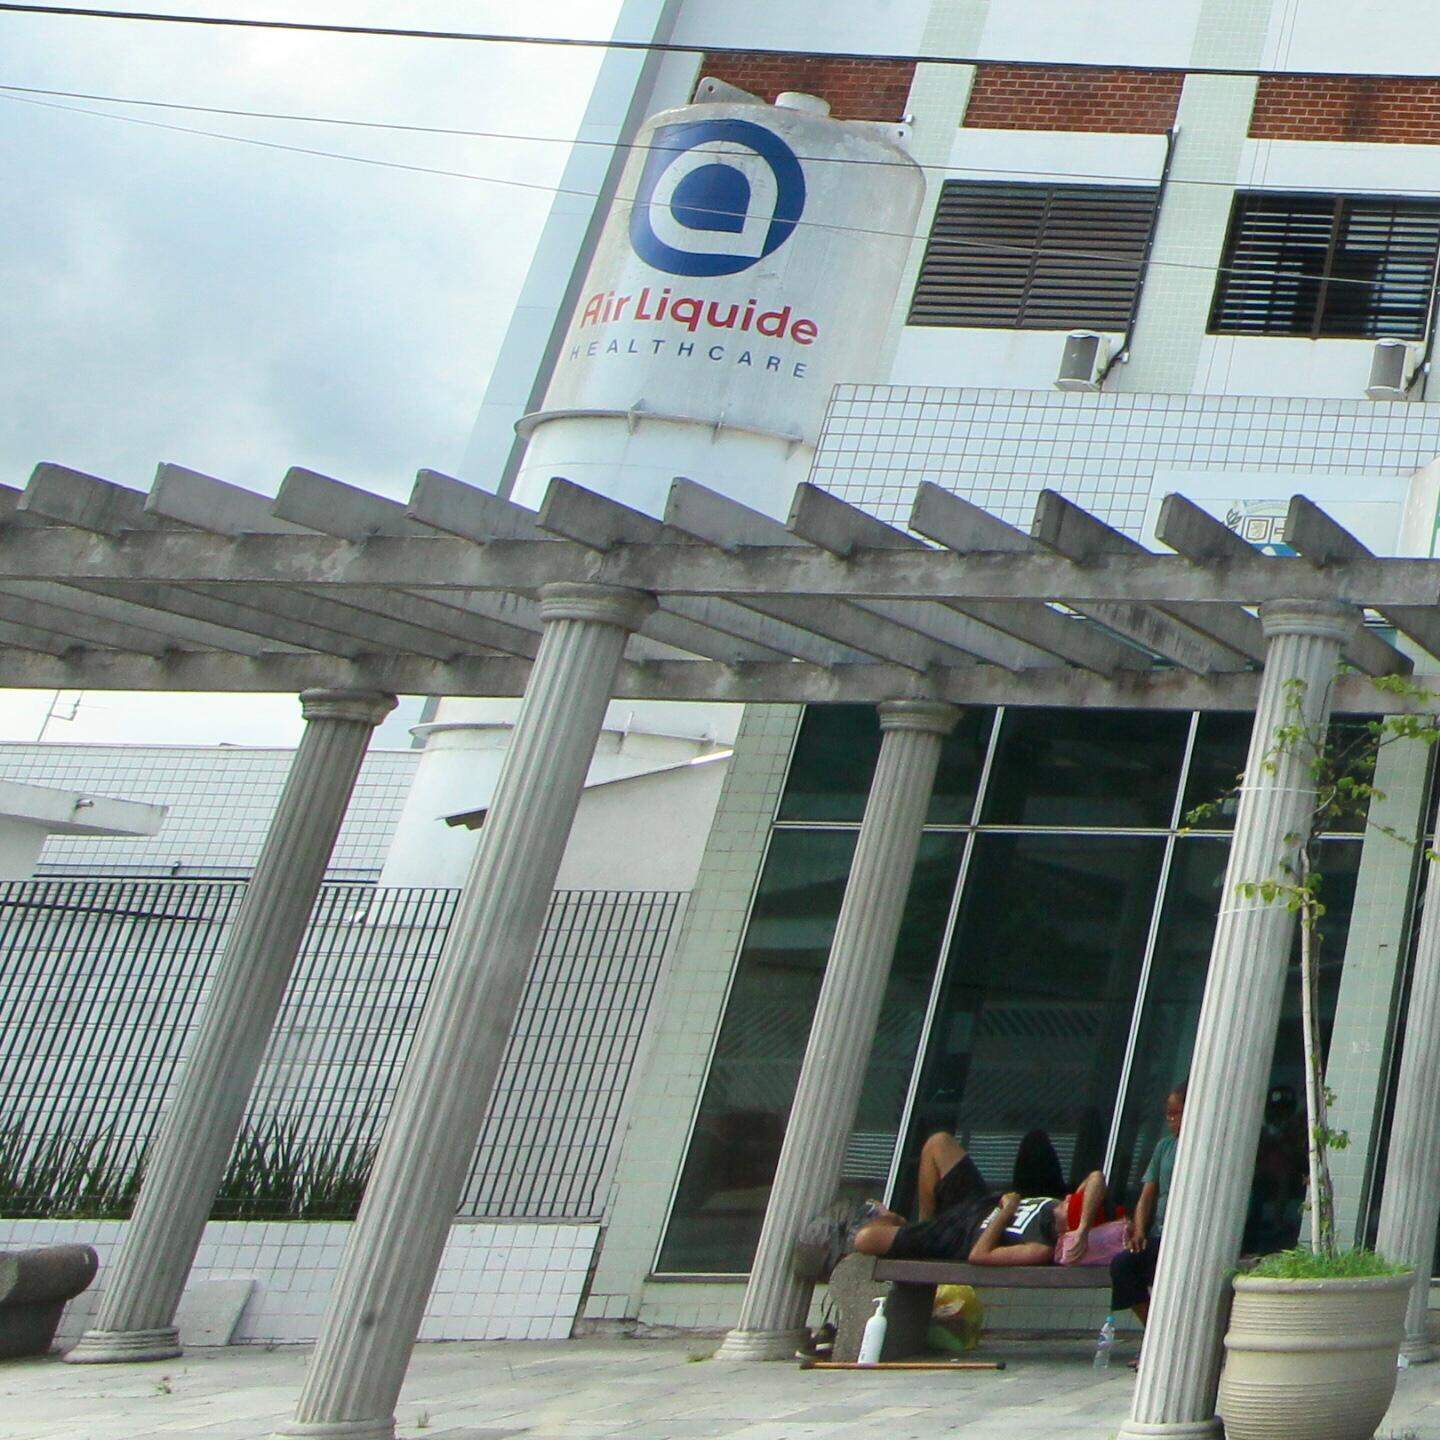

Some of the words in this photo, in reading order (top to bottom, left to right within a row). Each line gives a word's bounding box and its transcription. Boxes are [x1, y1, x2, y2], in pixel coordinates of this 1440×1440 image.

[581, 292, 630, 328] Air
[635, 288, 818, 345] Liquide
[570, 339, 808, 379] HEALTHCARE
